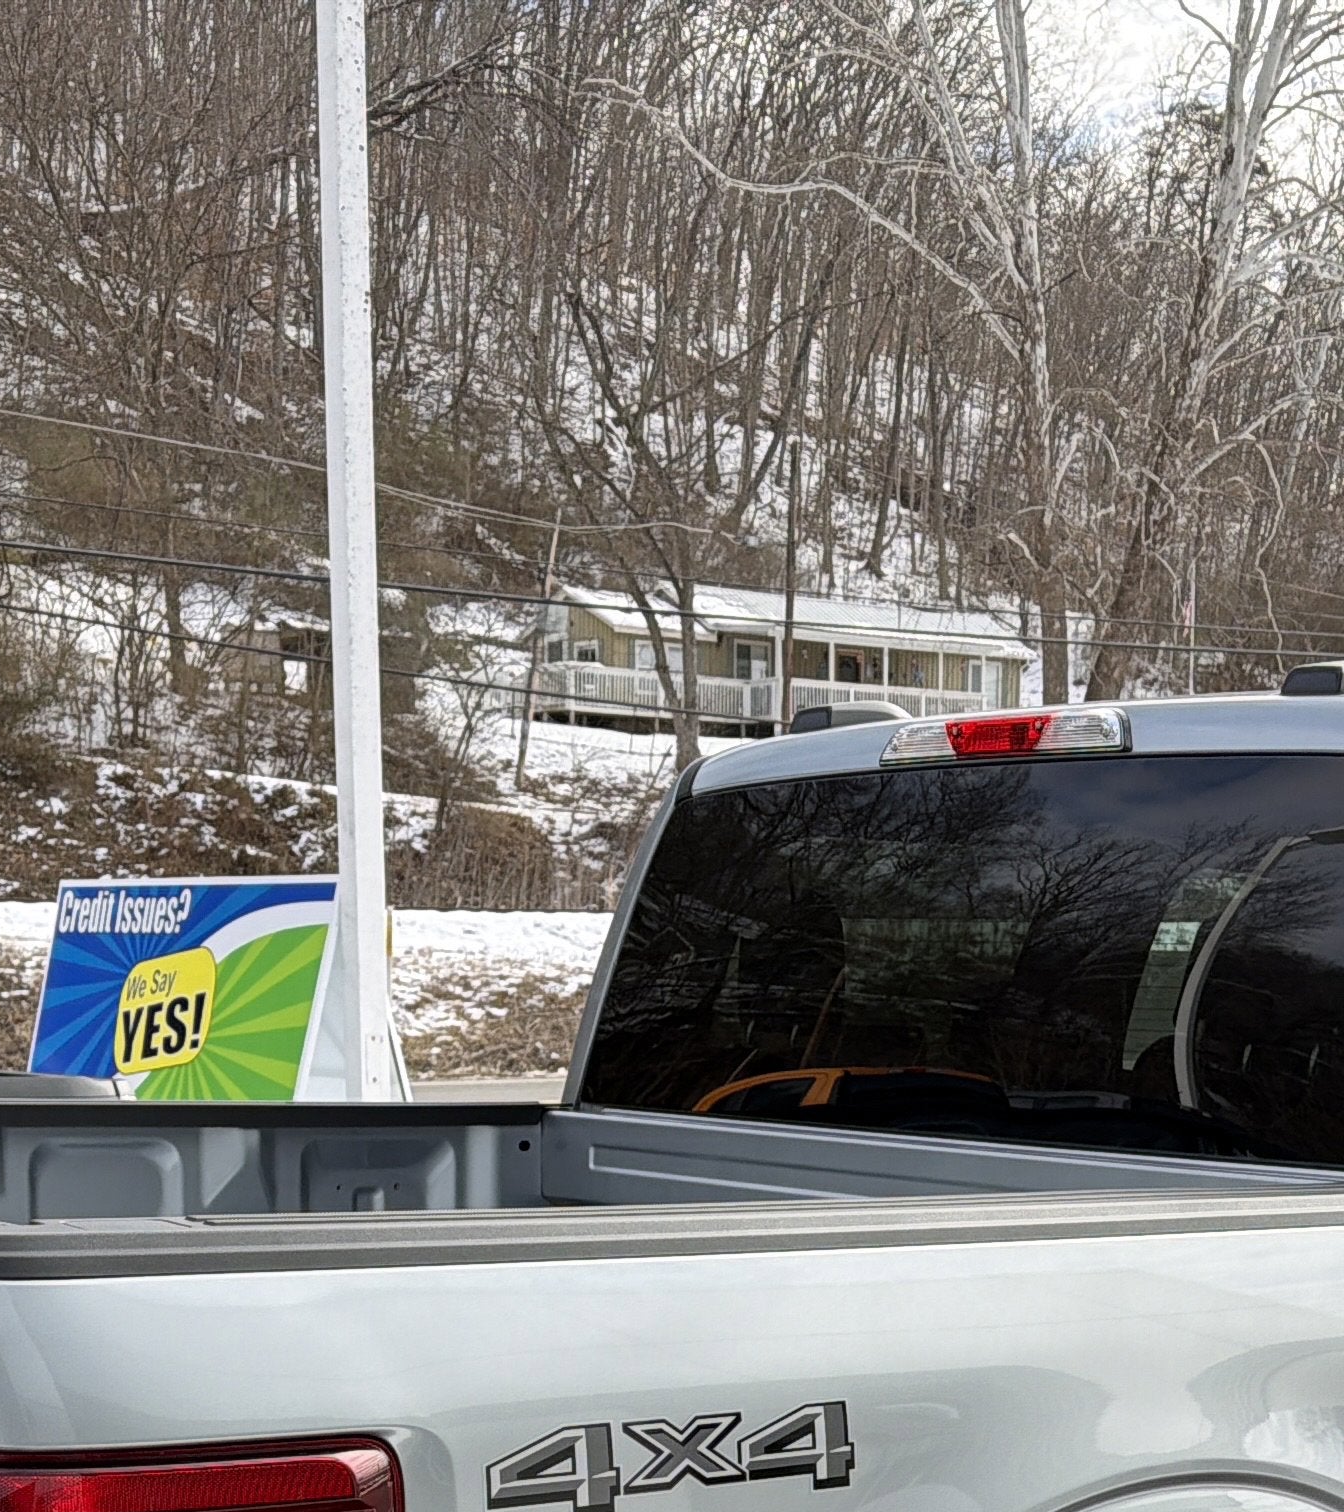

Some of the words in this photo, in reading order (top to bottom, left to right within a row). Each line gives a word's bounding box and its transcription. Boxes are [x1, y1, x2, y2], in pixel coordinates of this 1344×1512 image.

[59, 889, 114, 934] Credit
[114, 888, 192, 934] Issues?
[127, 976, 147, 999] We
[151, 969, 176, 997] Say
[122, 992, 206, 1063] YES!
